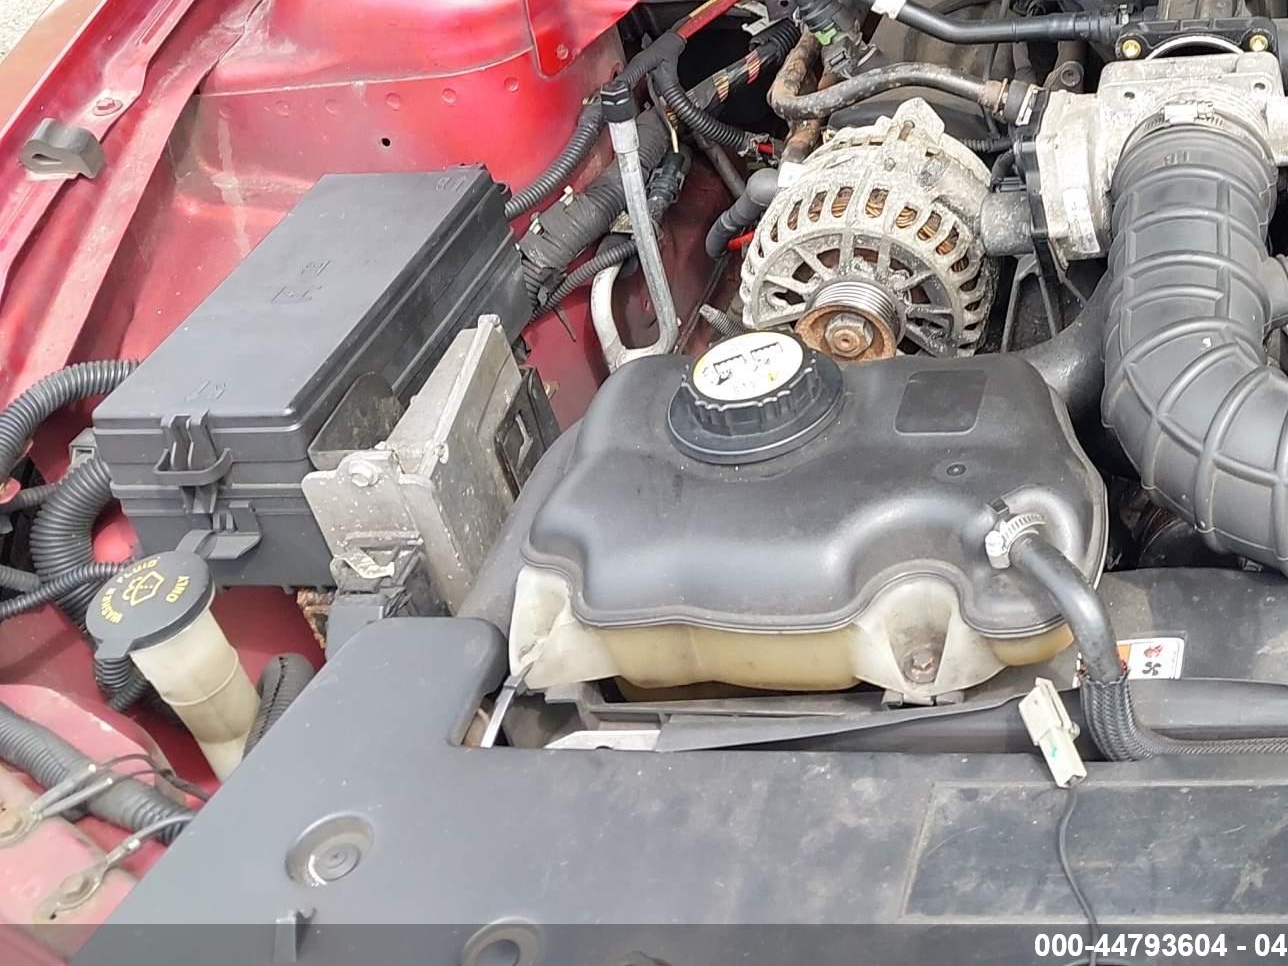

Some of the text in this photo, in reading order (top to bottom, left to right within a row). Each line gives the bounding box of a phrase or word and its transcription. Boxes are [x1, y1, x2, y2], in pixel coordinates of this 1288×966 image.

[101, 559, 190, 623] WASHER FLUID ONLY
